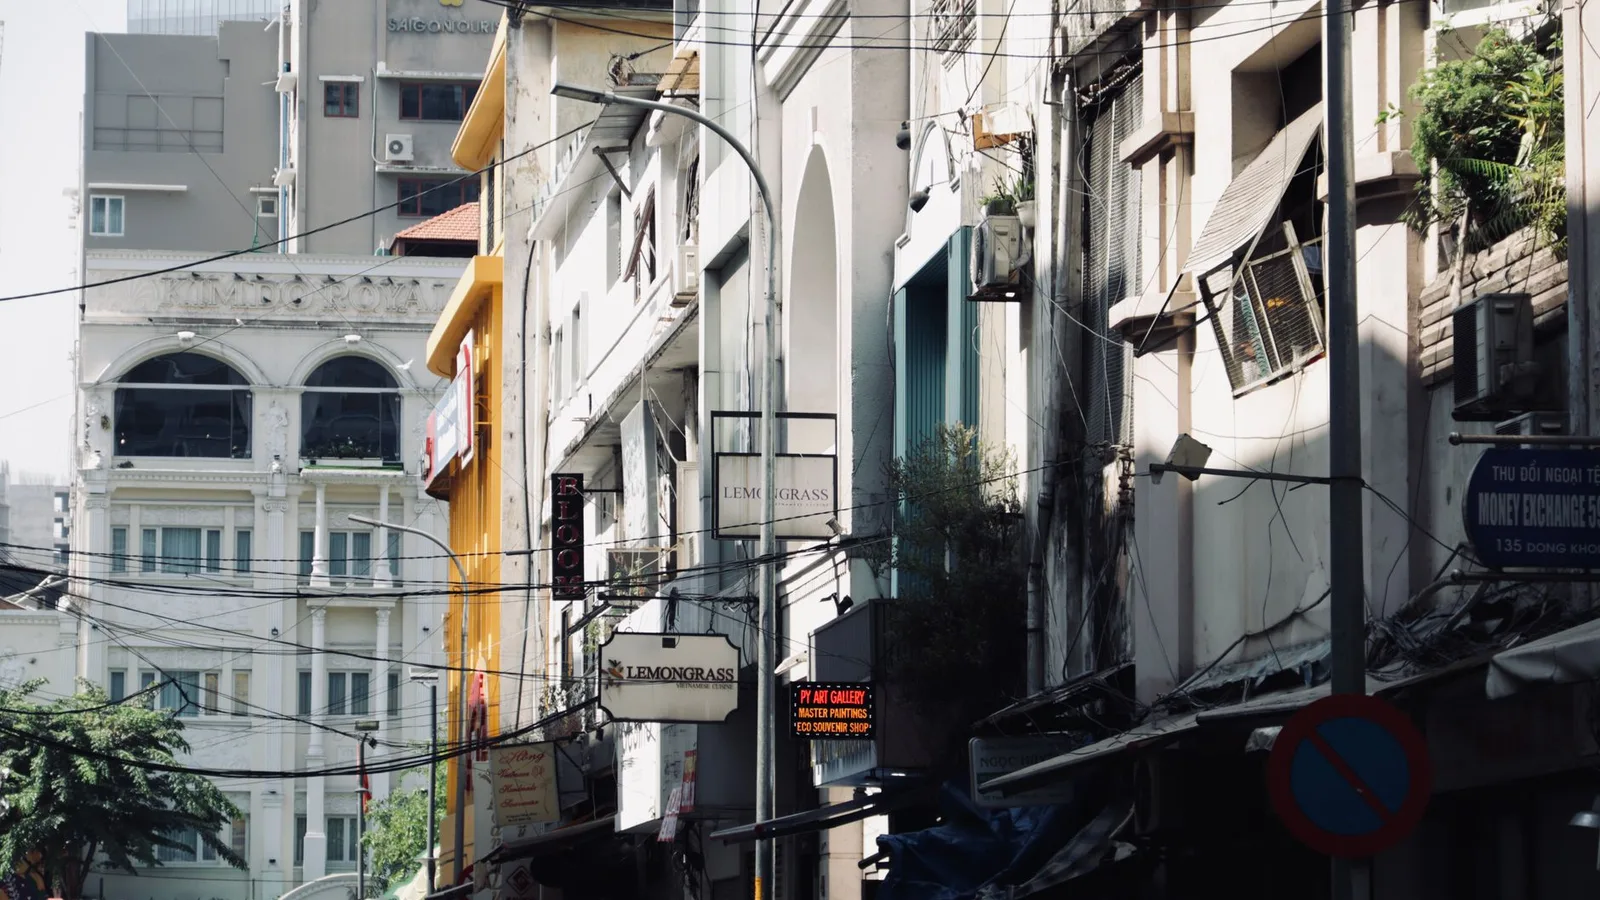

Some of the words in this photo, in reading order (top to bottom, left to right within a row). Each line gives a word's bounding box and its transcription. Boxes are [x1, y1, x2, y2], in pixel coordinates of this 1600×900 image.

[1492, 466, 1515, 481] THU
[1545, 467, 1582, 486] NGOẠI
[1478, 491, 1520, 526] MONEY
[1523, 493, 1586, 527] EXCHANGE
[555, 476, 583, 595] BLOOM
[1496, 538, 1522, 552] 135
[1526, 542, 1566, 554] DONG
[626, 666, 734, 681] LEMONGRASS
[676, 682, 710, 690] VIETNAMESE
[800, 689, 811, 704] PY
[813, 690, 828, 704] ART
[830, 690, 865, 704] GALLERY
[798, 707, 828, 719] MASTER
[829, 708, 868, 719] PAINTINGS
[797, 721, 811, 732] ECO
[813, 722, 848, 733] SOUVENIR
[849, 722, 869, 733] SHOP
